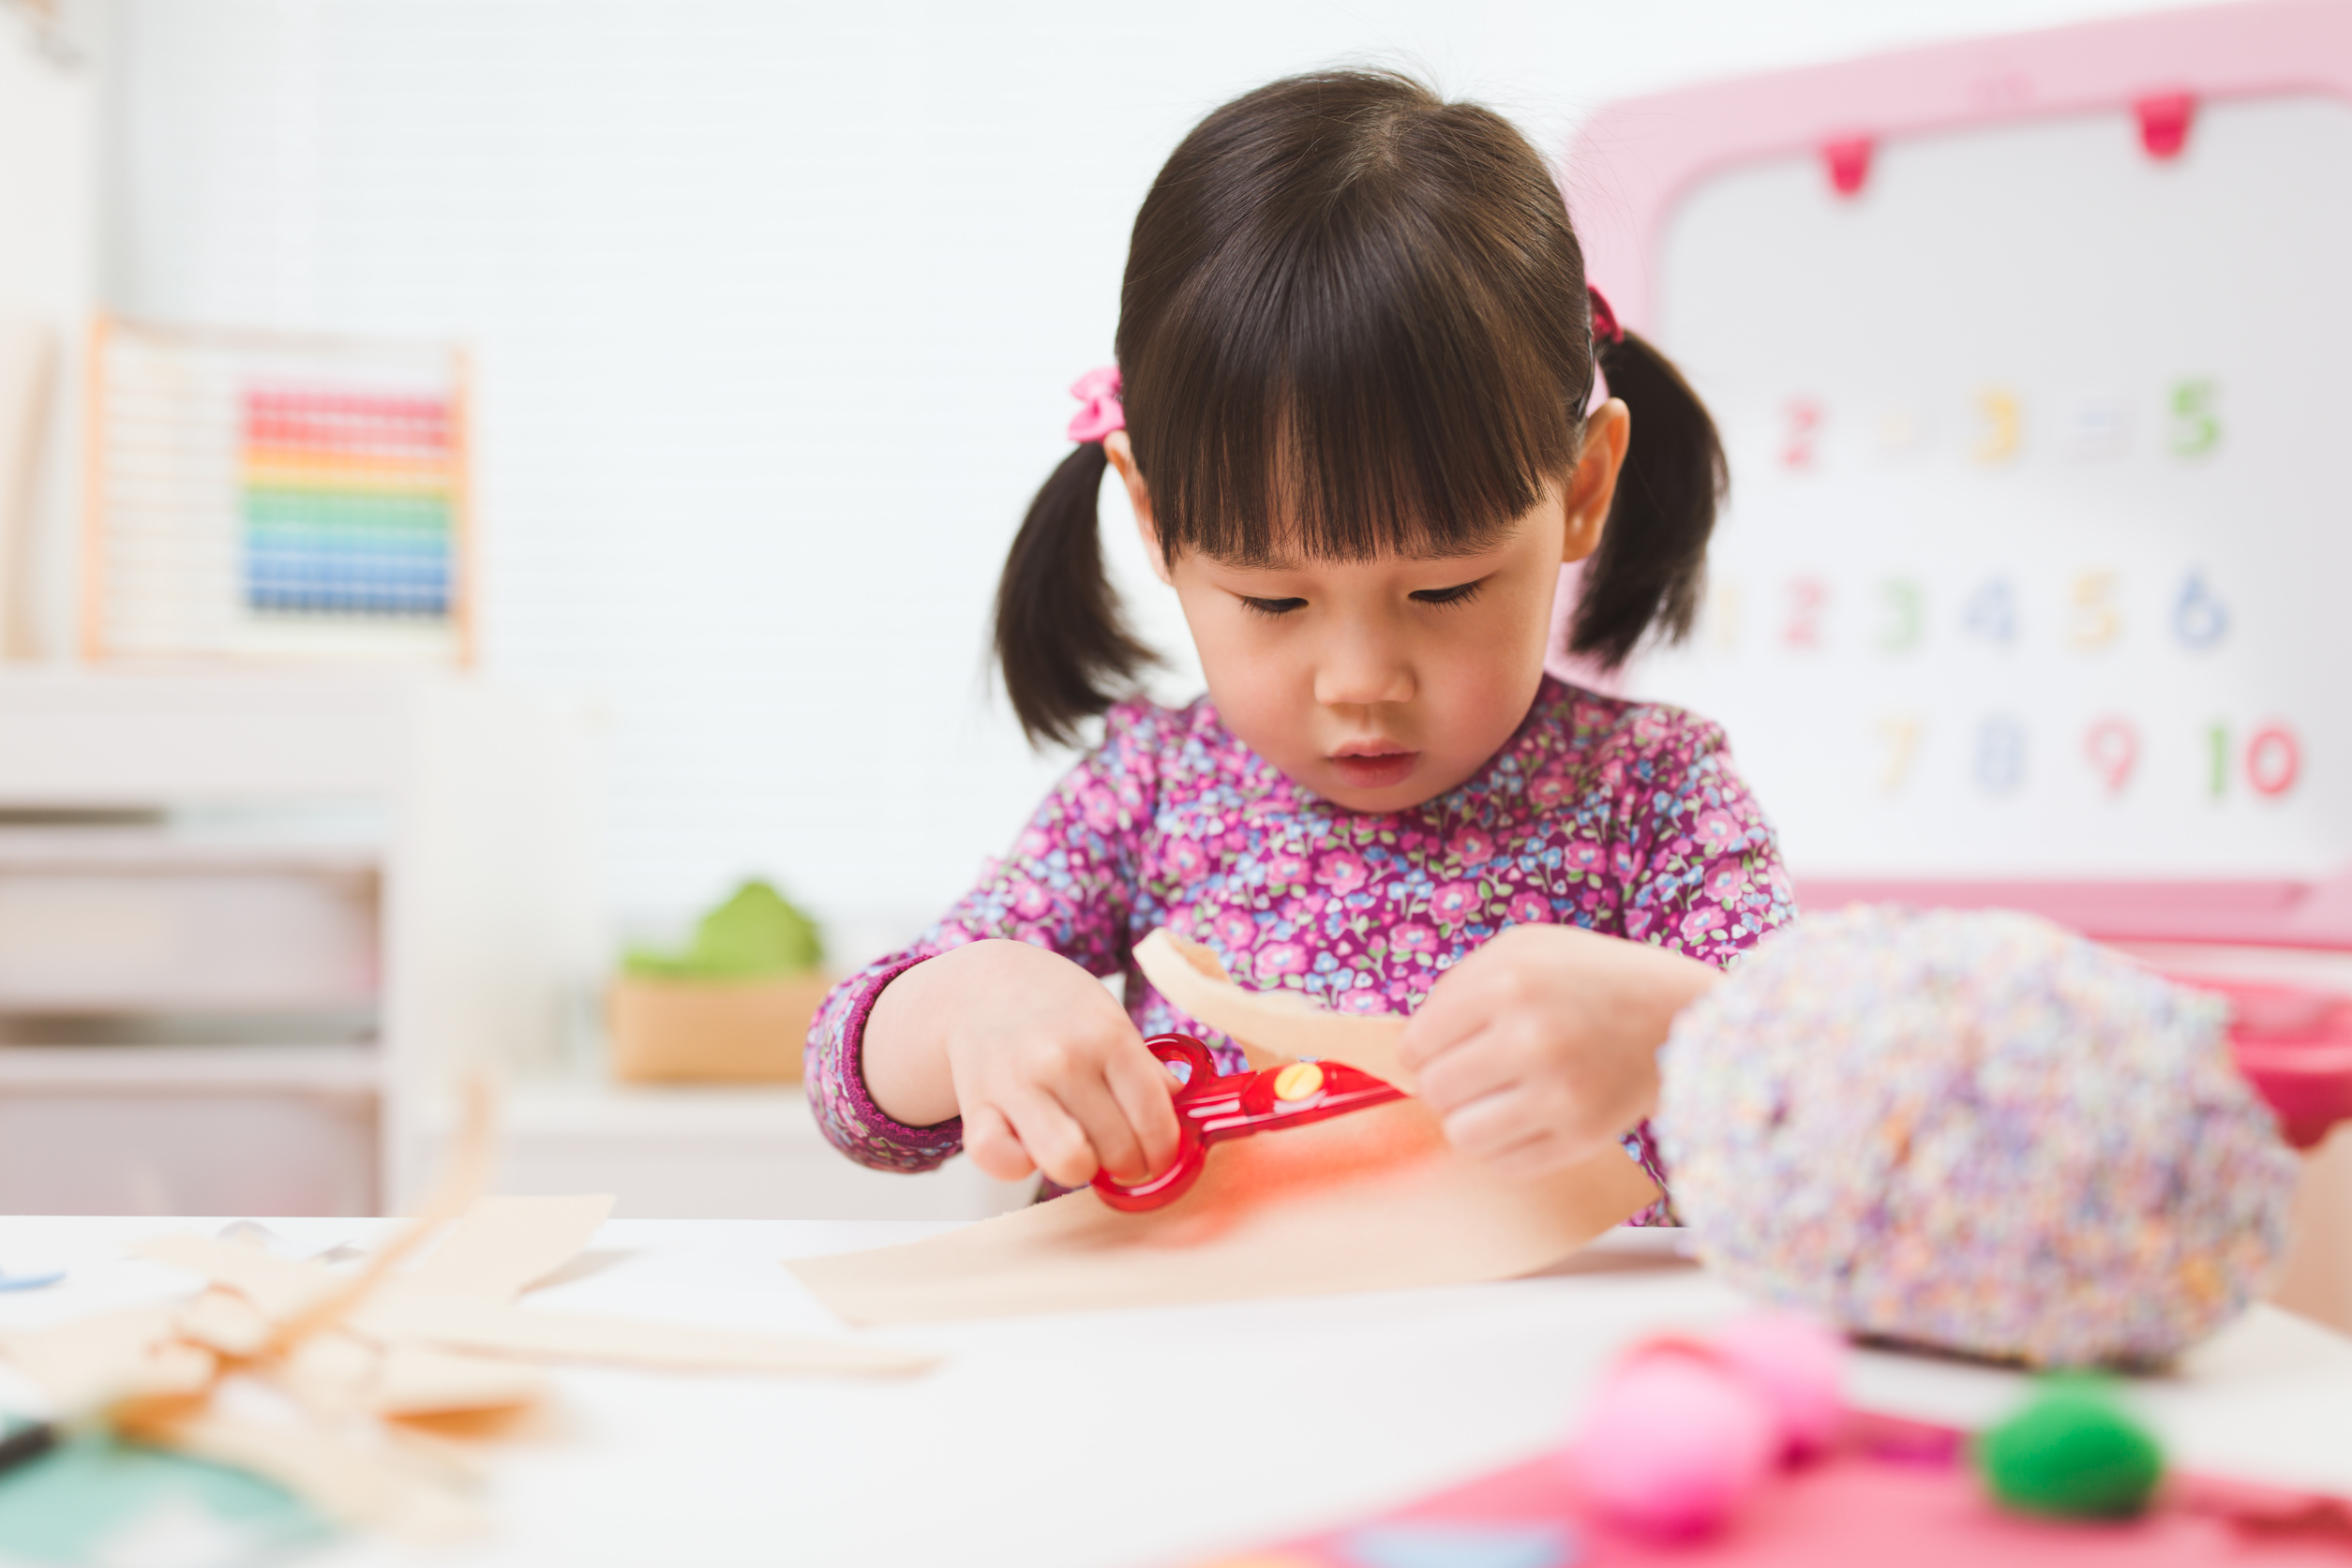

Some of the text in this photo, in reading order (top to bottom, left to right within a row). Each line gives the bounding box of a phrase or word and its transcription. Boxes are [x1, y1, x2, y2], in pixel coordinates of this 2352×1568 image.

[1777, 395, 1828, 473] 2
[1966, 382, 2025, 468] 3
[2166, 375, 2223, 462] 5
[1779, 573, 1831, 650] 2
[1877, 574, 1924, 651] 3
[1961, 572, 2019, 647] 4
[2068, 567, 2122, 650] 5
[2169, 564, 2230, 651] 6
[1875, 714, 1923, 792] 7
[2081, 713, 2140, 798] 9
[2205, 716, 2302, 799] 10
